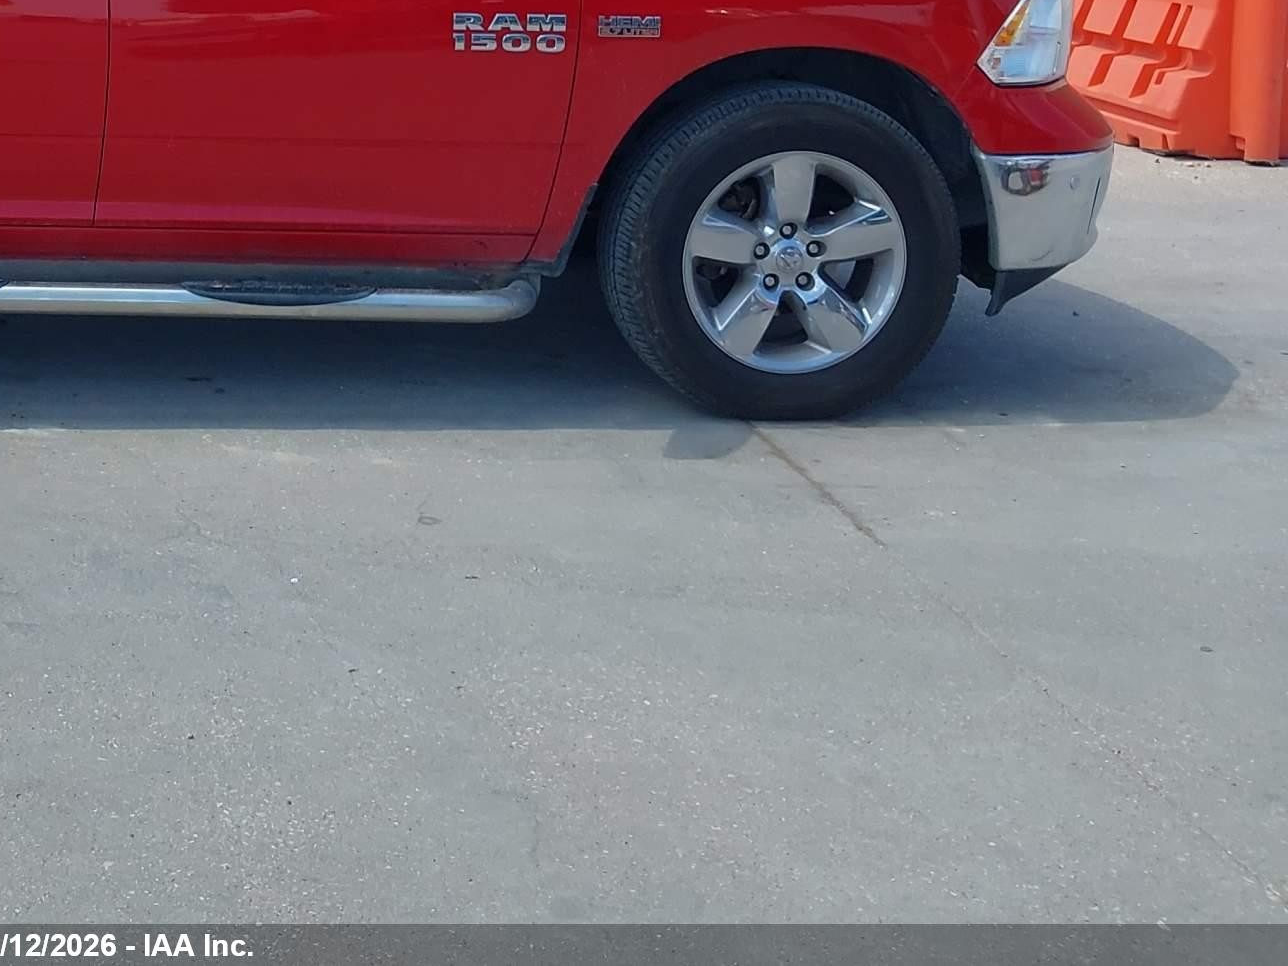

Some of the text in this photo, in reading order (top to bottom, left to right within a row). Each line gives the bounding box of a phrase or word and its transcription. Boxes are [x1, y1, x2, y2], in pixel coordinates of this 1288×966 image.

[453, 13, 567, 32] RAM
[598, 15, 661, 28] HEMI
[453, 34, 566, 53] 1500
